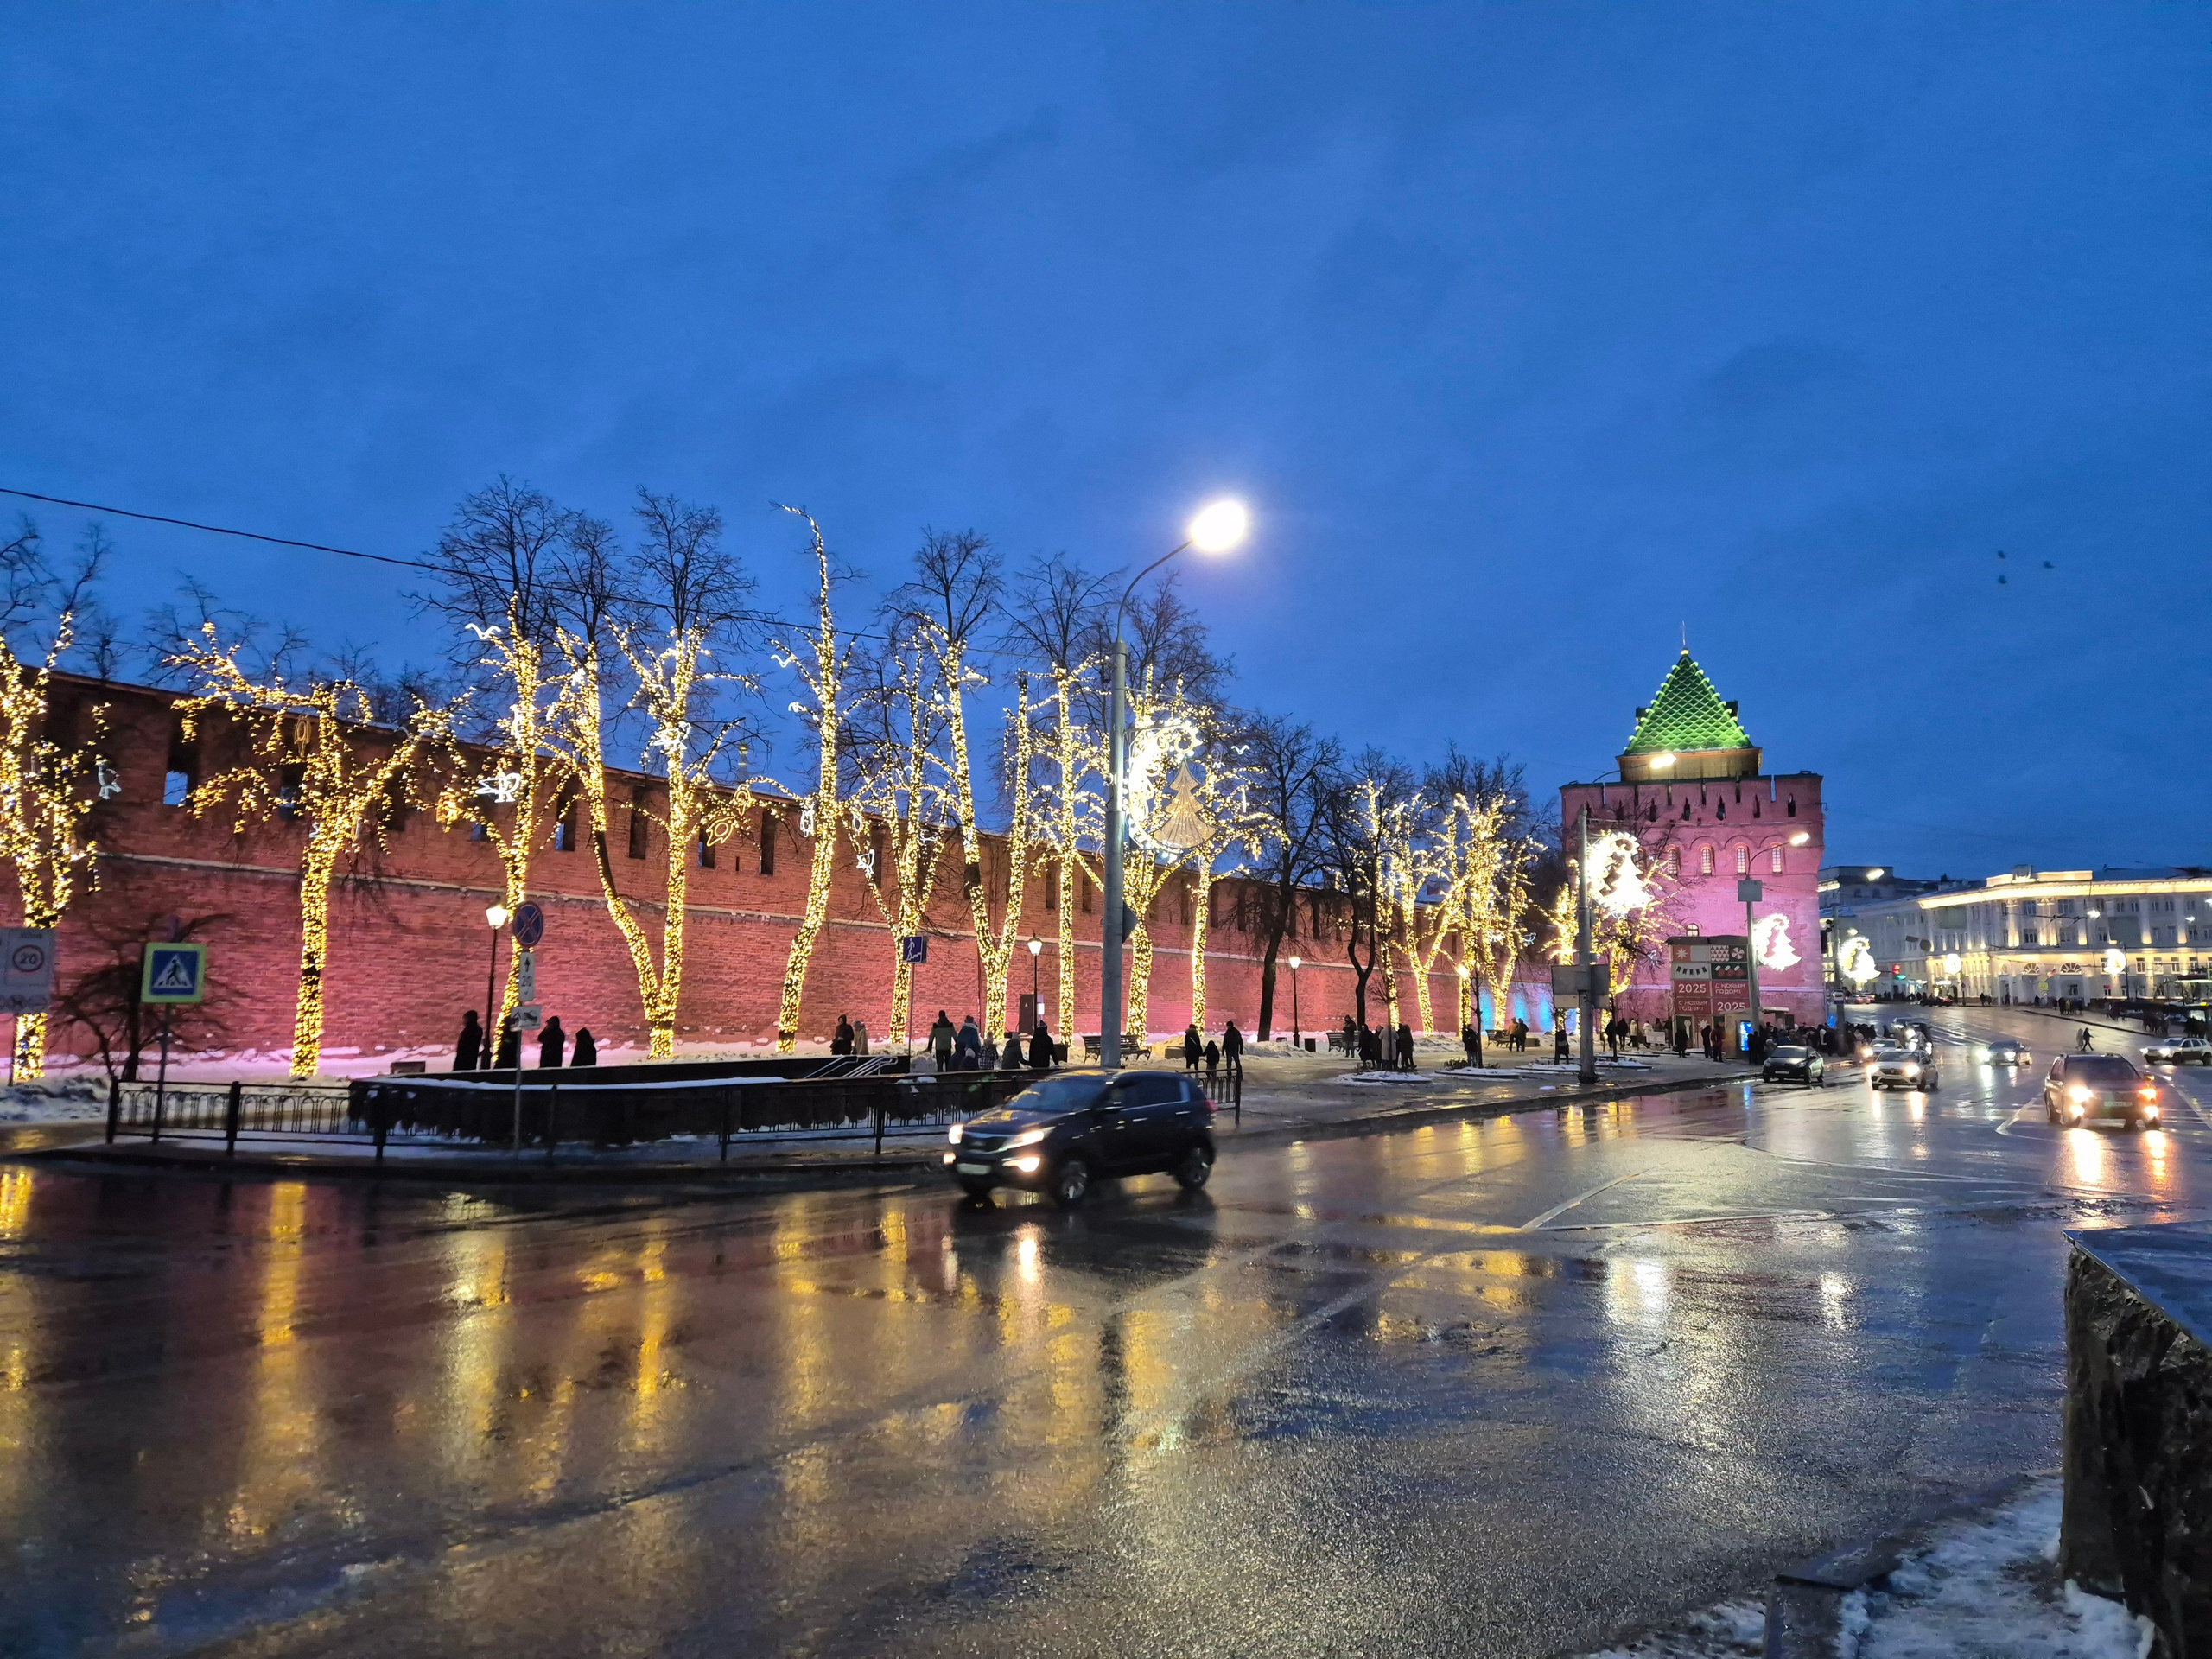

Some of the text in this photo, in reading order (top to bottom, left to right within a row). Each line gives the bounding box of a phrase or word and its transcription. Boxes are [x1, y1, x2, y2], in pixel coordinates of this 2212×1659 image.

[20, 953, 37, 964] 20
[521, 976, 532, 987] 20
[1678, 983, 1707, 994] 2025
[1717, 1001, 1746, 1011] 2025
